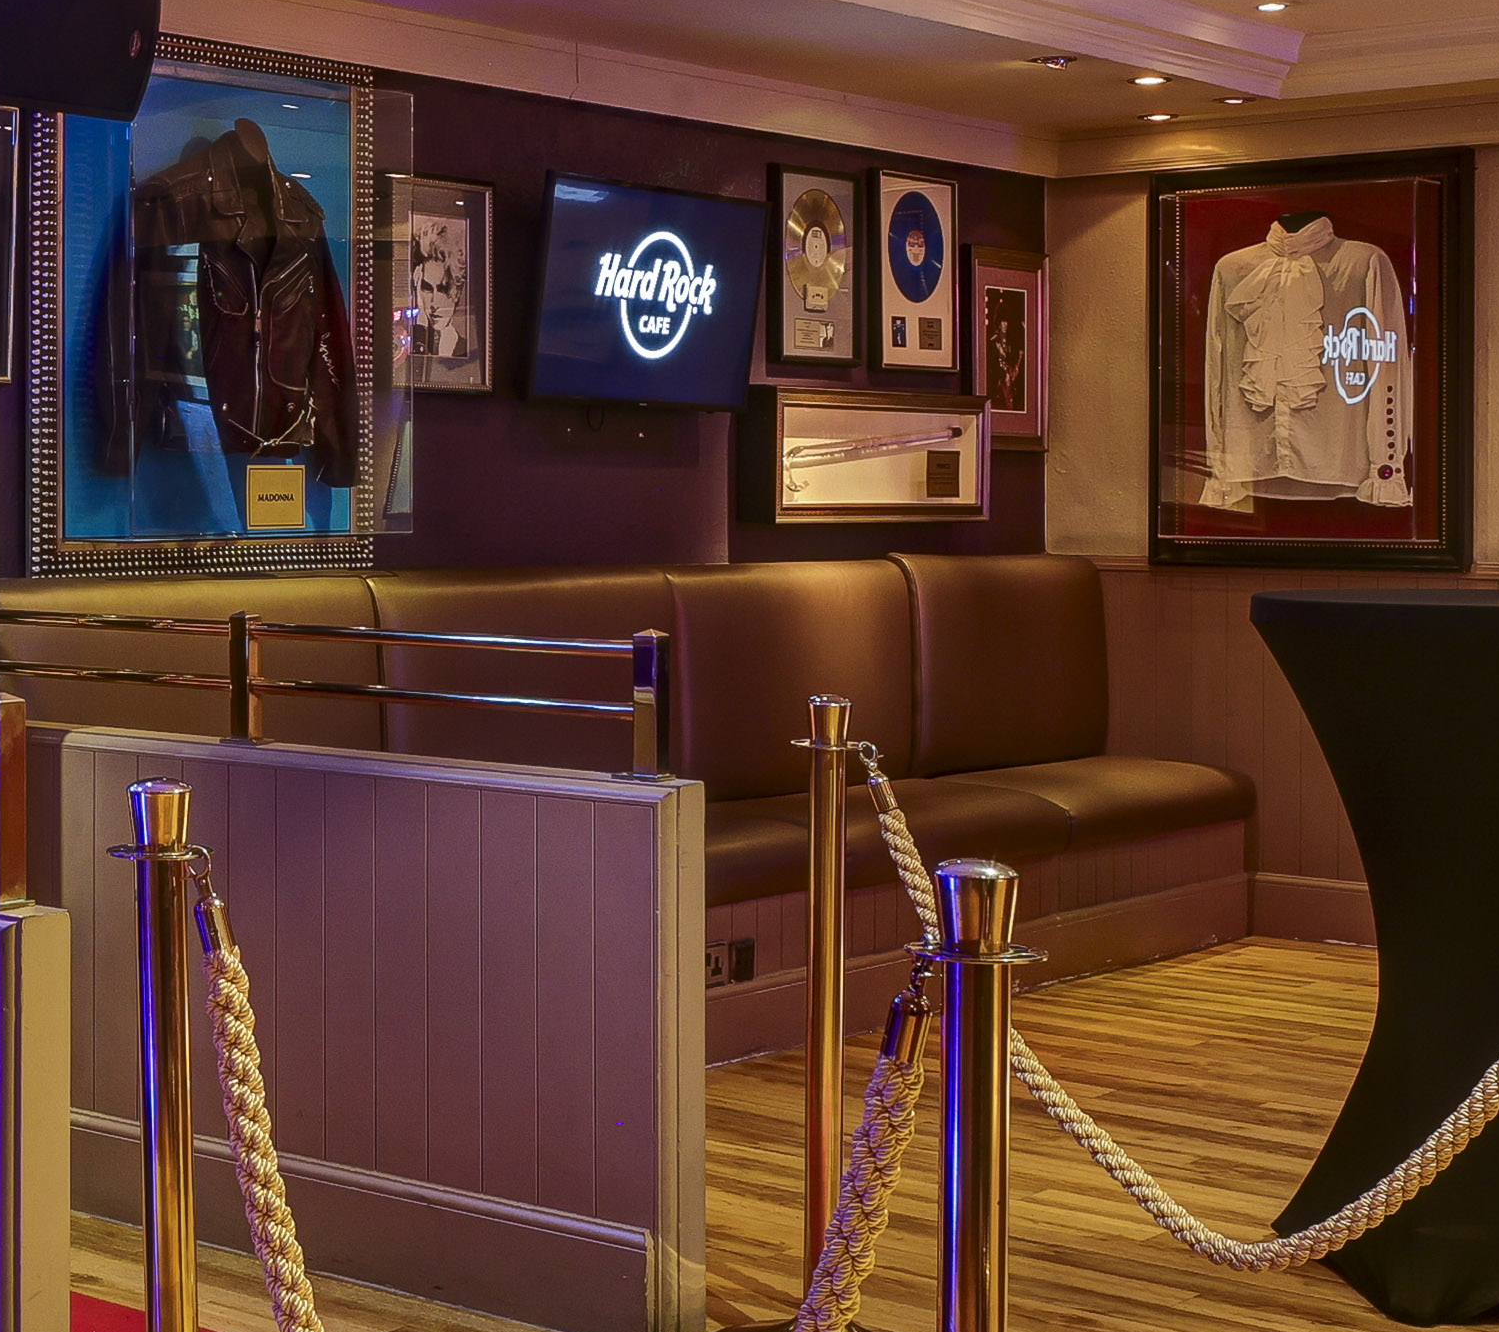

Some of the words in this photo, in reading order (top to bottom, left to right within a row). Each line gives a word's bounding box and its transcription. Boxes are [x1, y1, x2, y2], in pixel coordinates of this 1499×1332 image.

[594, 252, 663, 301] Hard
[657, 259, 717, 315] Rock
[638, 314, 671, 335] CAFE
[257, 493, 295, 502] MADONNA
